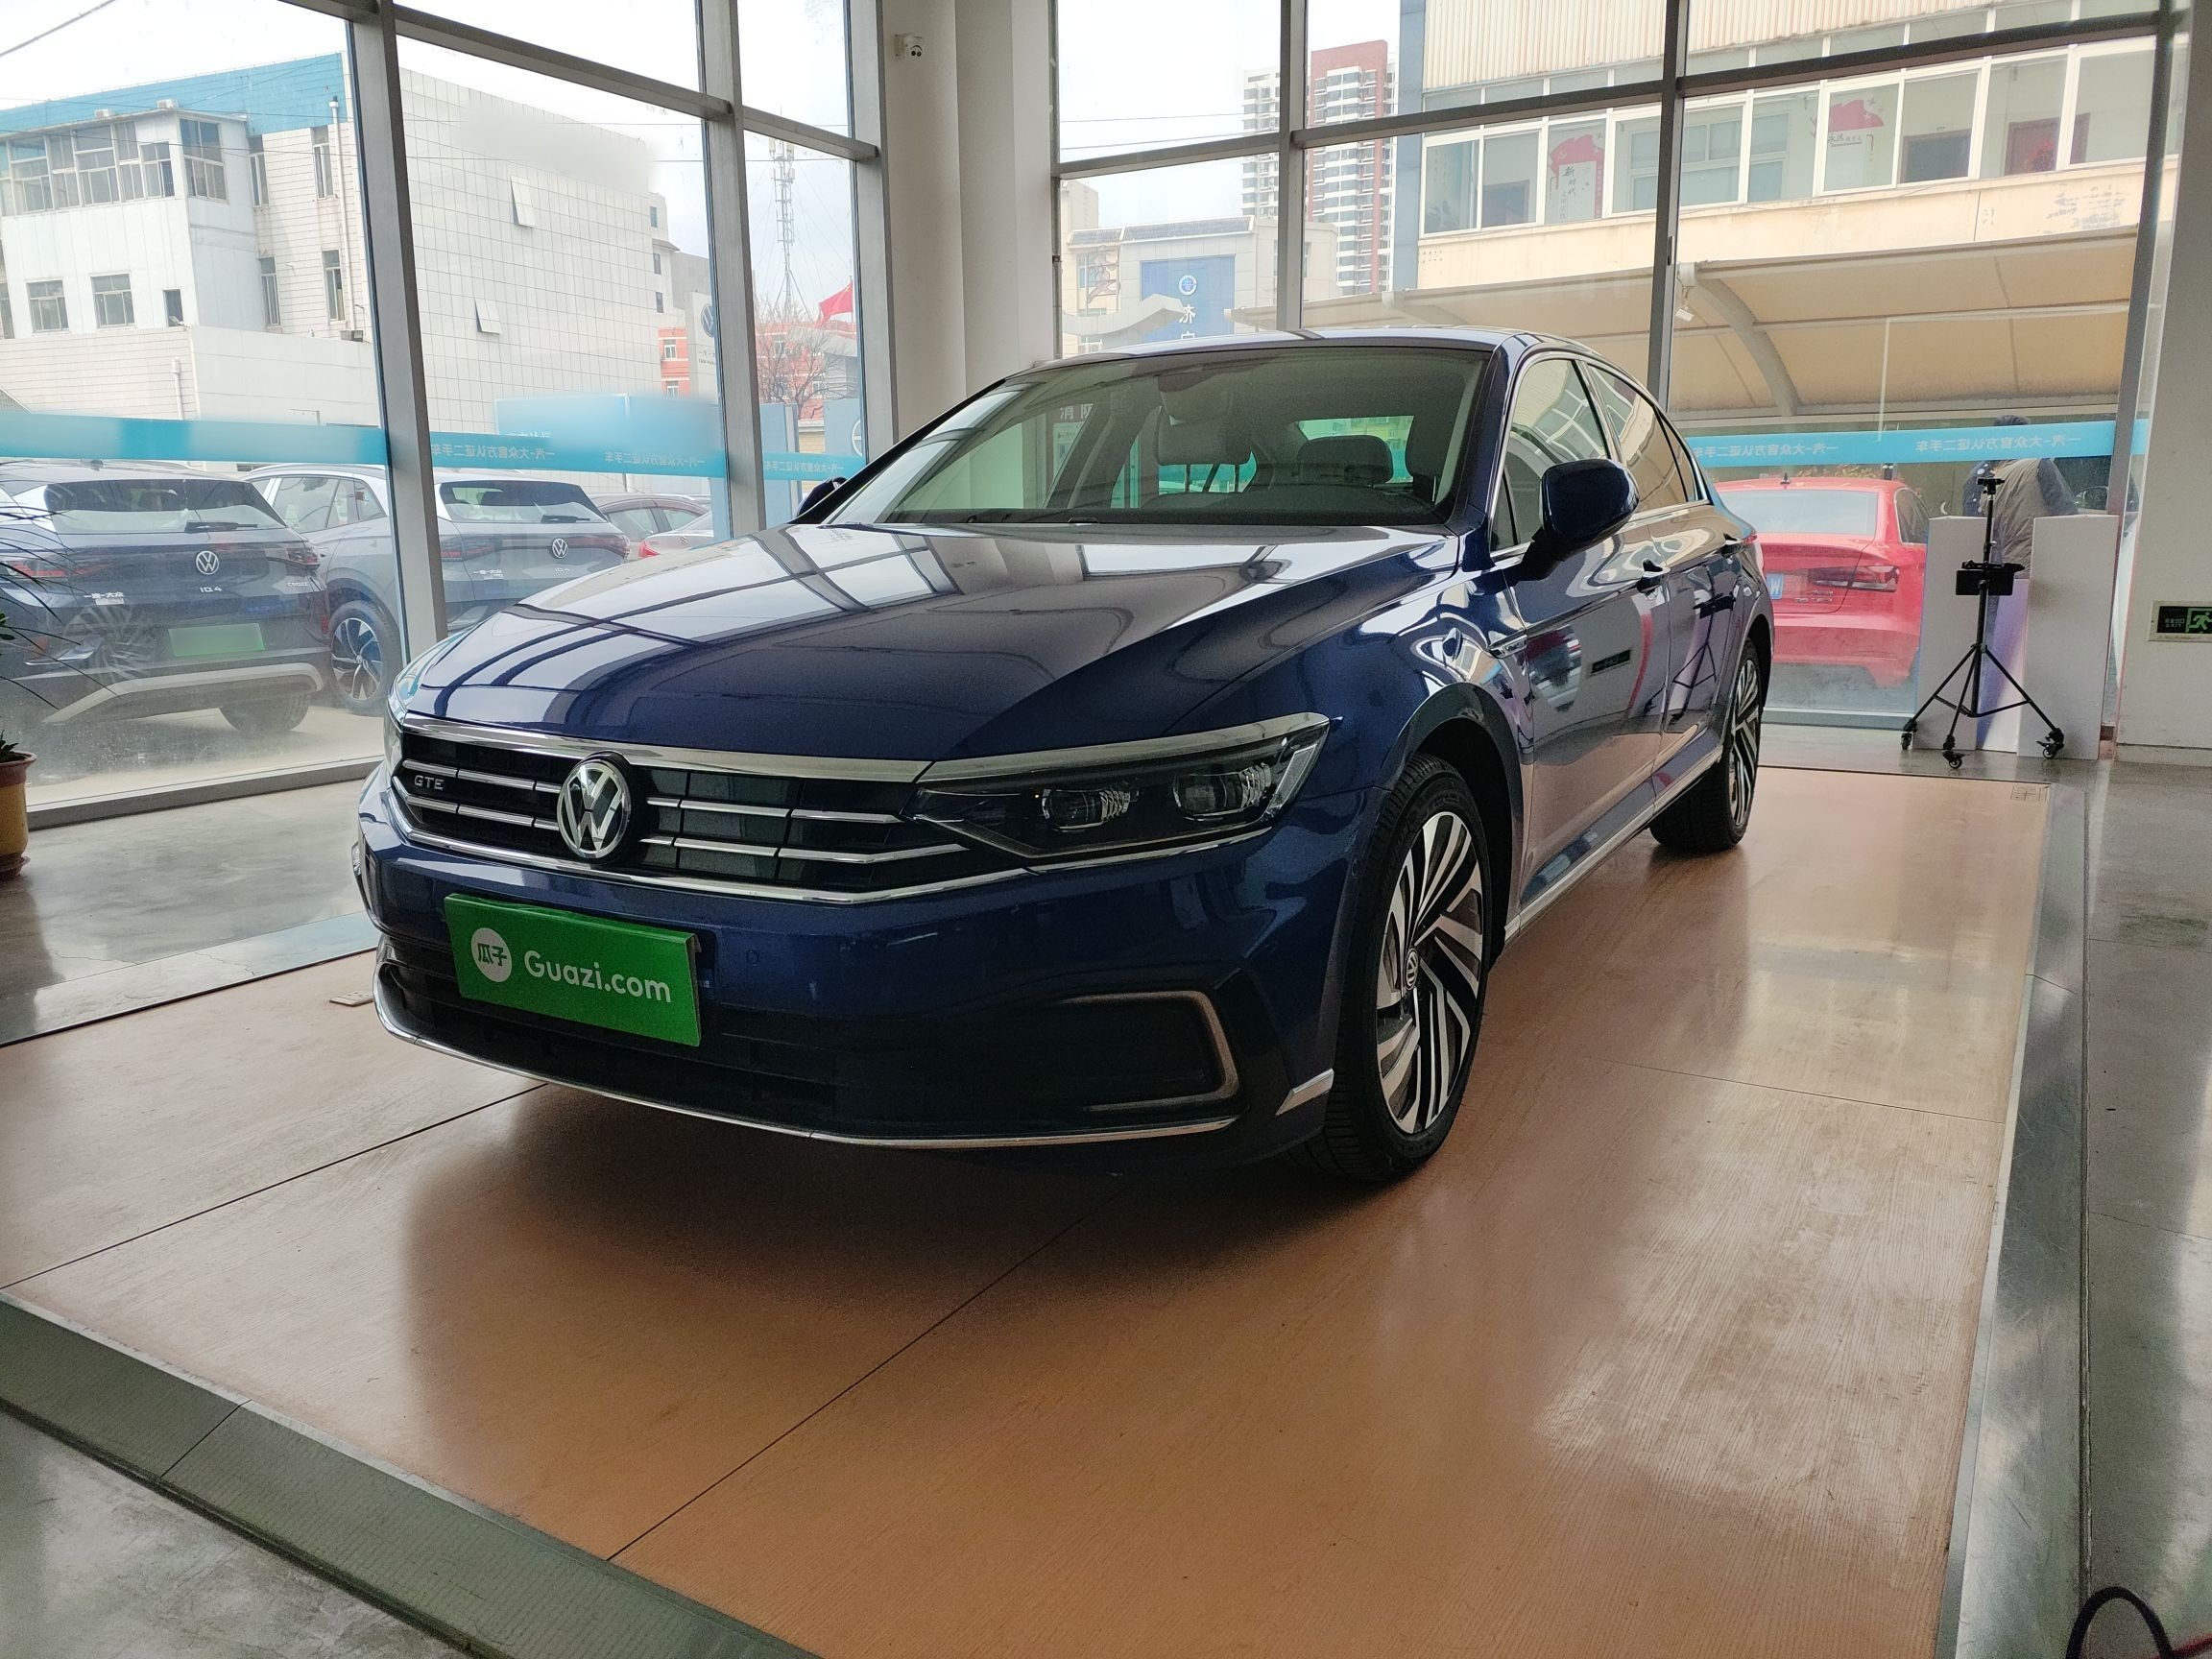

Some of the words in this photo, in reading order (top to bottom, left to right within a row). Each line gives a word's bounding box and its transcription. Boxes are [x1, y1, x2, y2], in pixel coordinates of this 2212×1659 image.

[414, 774, 445, 792] GTE
[476, 941, 508, 968] 瓜子
[523, 950, 672, 1004] Guazi.com
